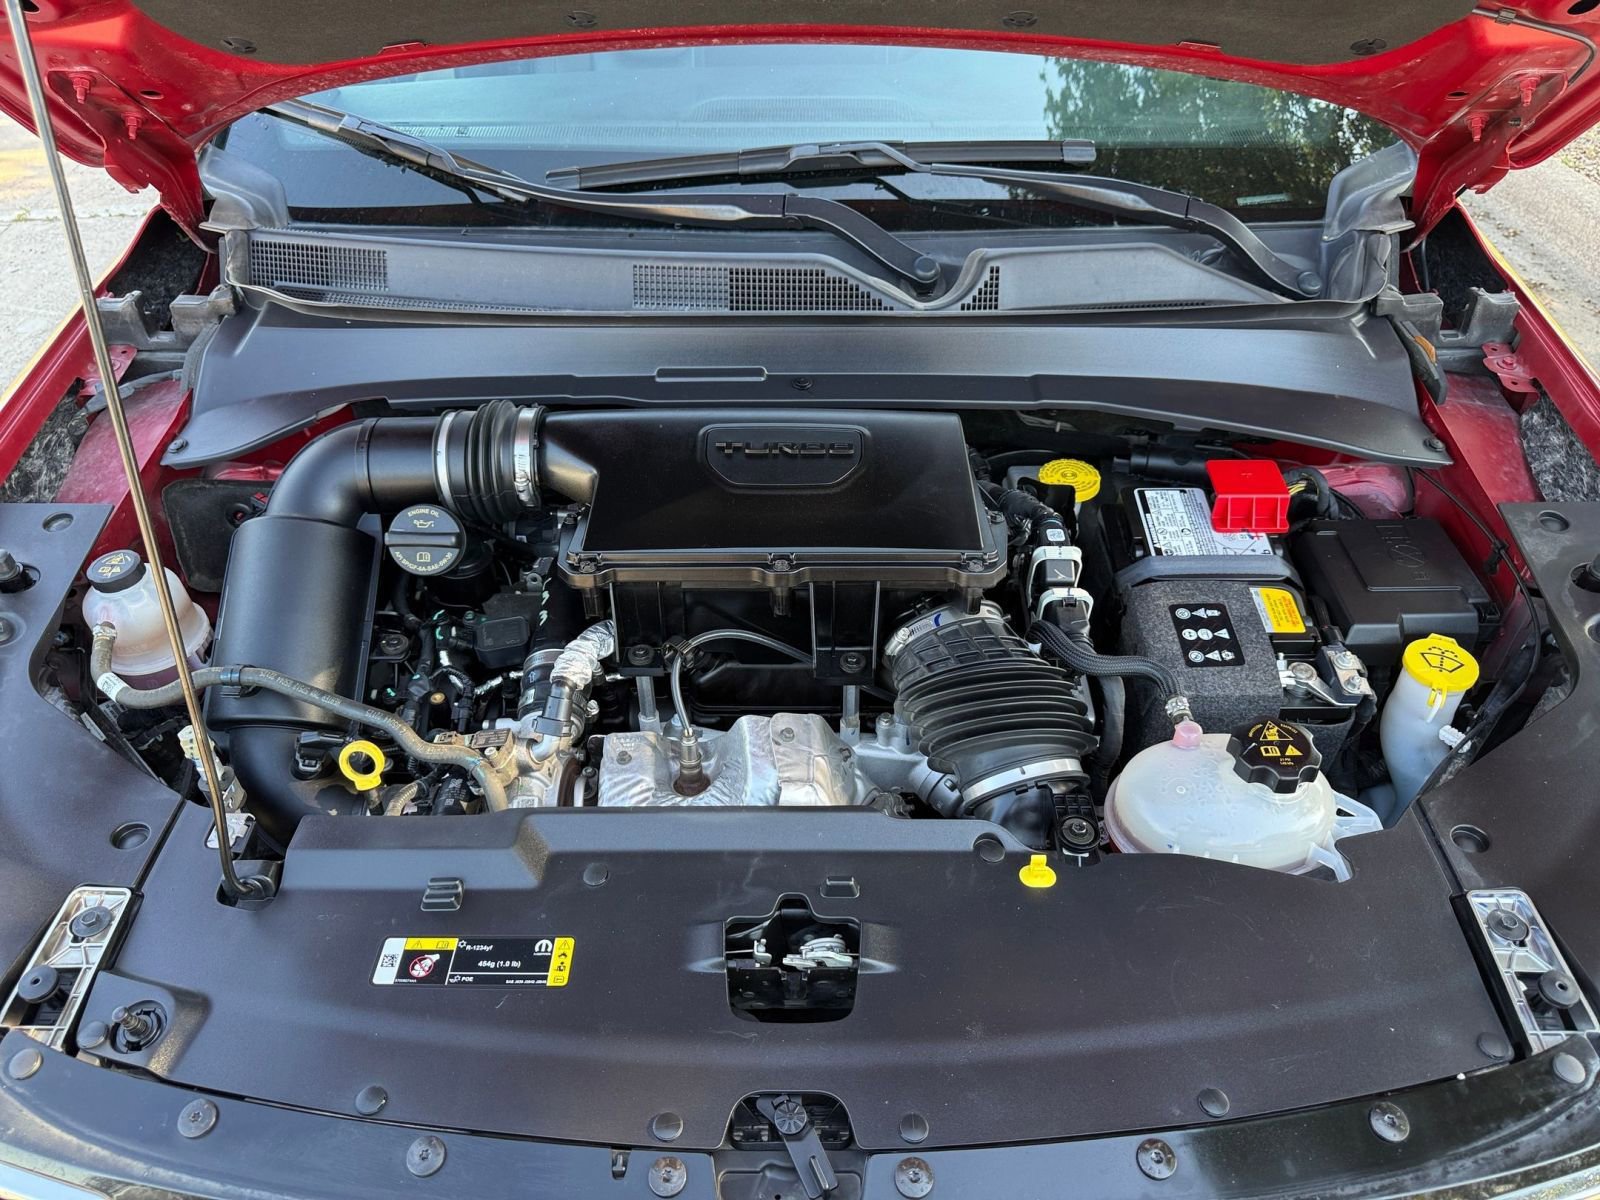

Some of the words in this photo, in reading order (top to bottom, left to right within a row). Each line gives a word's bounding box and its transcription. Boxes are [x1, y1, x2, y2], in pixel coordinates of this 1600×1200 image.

[408, 508, 430, 517] ENGINE
[430, 509, 439, 518] OIL
[478, 960, 496, 968] 454g
[496, 960, 510, 968] (1.0
[511, 960, 521, 969] lb)
